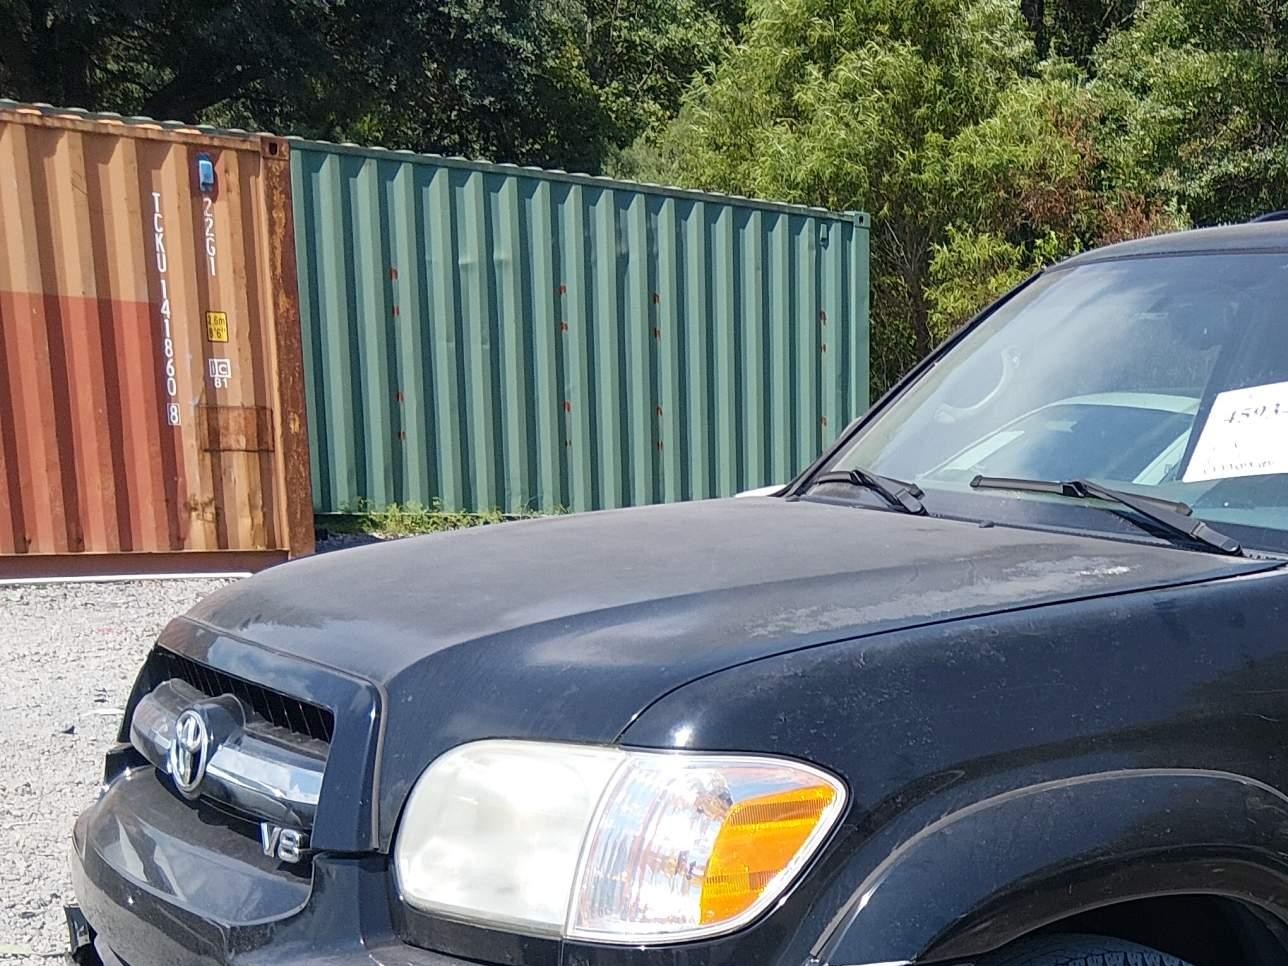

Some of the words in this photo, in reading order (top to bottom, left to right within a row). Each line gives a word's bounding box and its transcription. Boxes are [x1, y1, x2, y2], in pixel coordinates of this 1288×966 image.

[152, 192, 167, 273] TCKU
[160, 279, 177, 396] 141860
[169, 404, 179, 424] 8
[261, 822, 301, 863] V8
